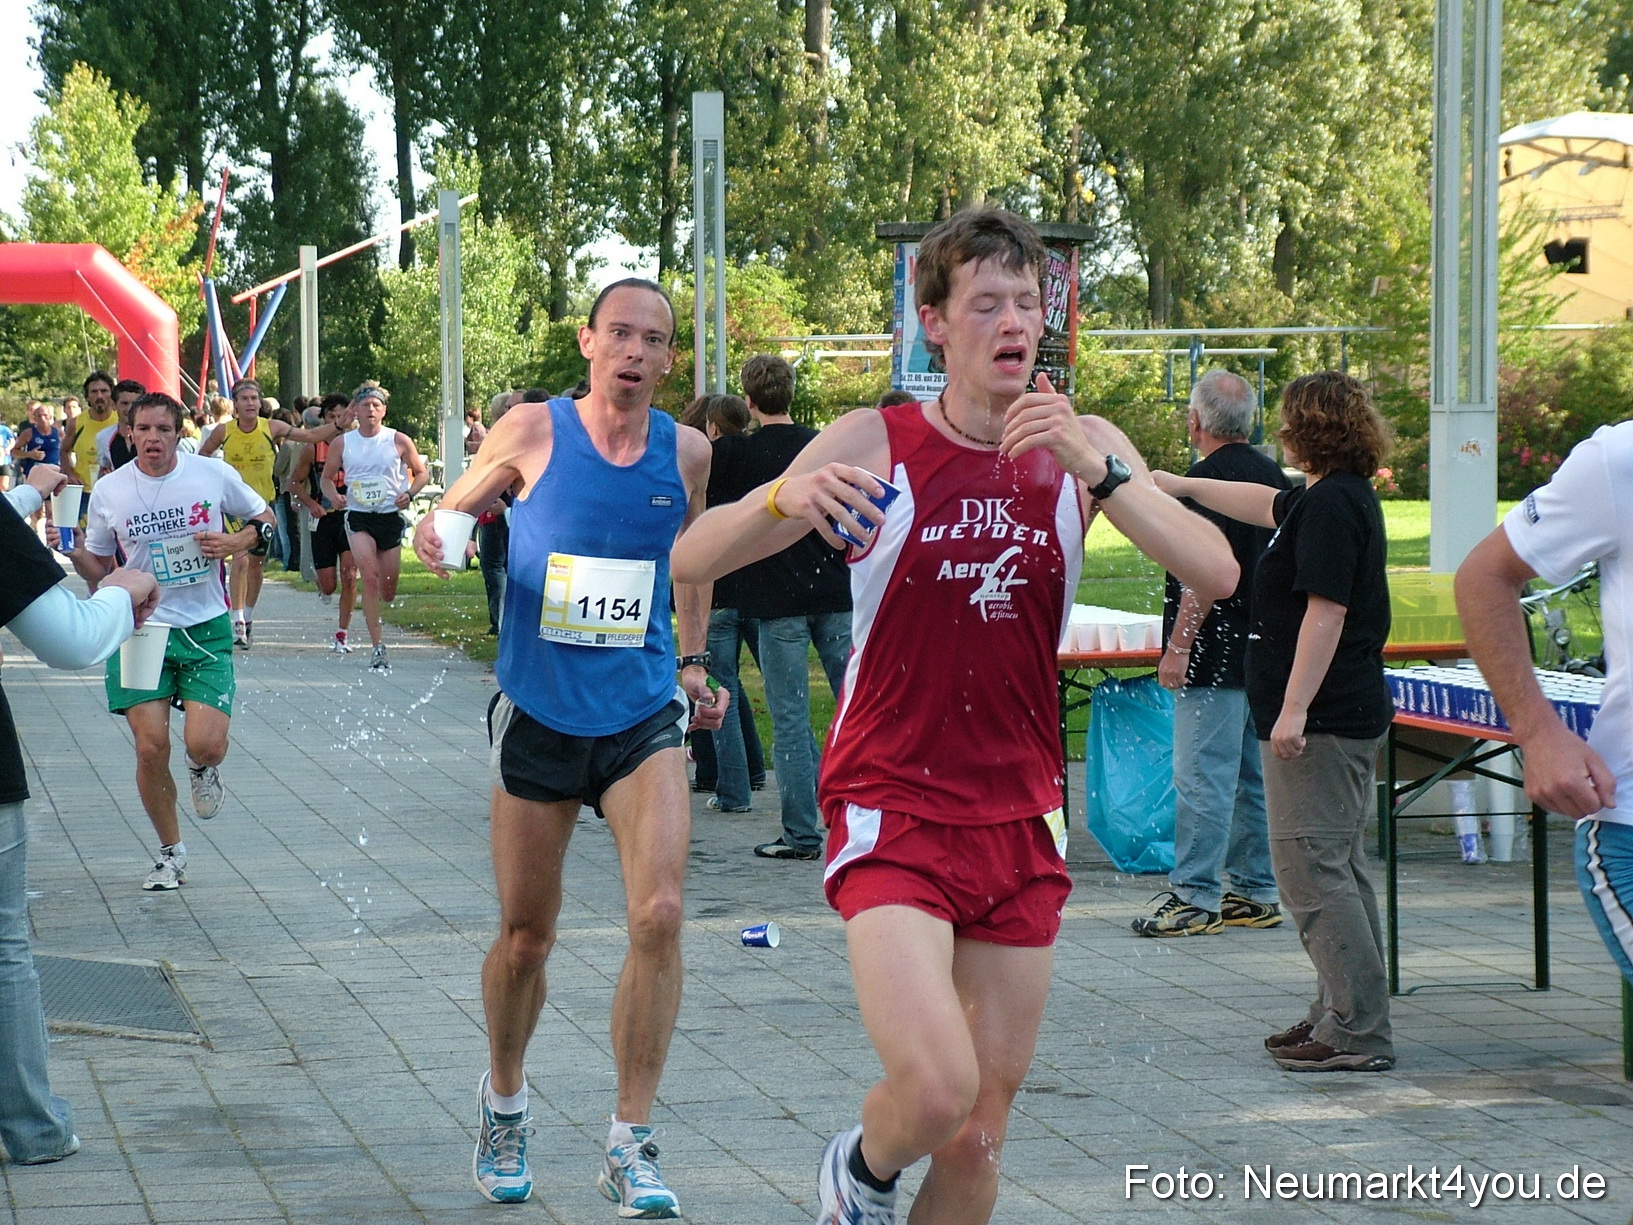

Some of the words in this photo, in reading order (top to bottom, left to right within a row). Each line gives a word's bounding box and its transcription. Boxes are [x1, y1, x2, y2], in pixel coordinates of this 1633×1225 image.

[934, 374, 942, 383] 20
[366, 490, 382, 499] 237
[126, 507, 184, 527] ARCADEN
[960, 498, 1017, 531] DJK
[129, 518, 186, 538] APOTHEKE
[167, 545, 184, 555] Ingo
[577, 596, 641, 621] 1154
[988, 602, 1014, 610] aerobic
